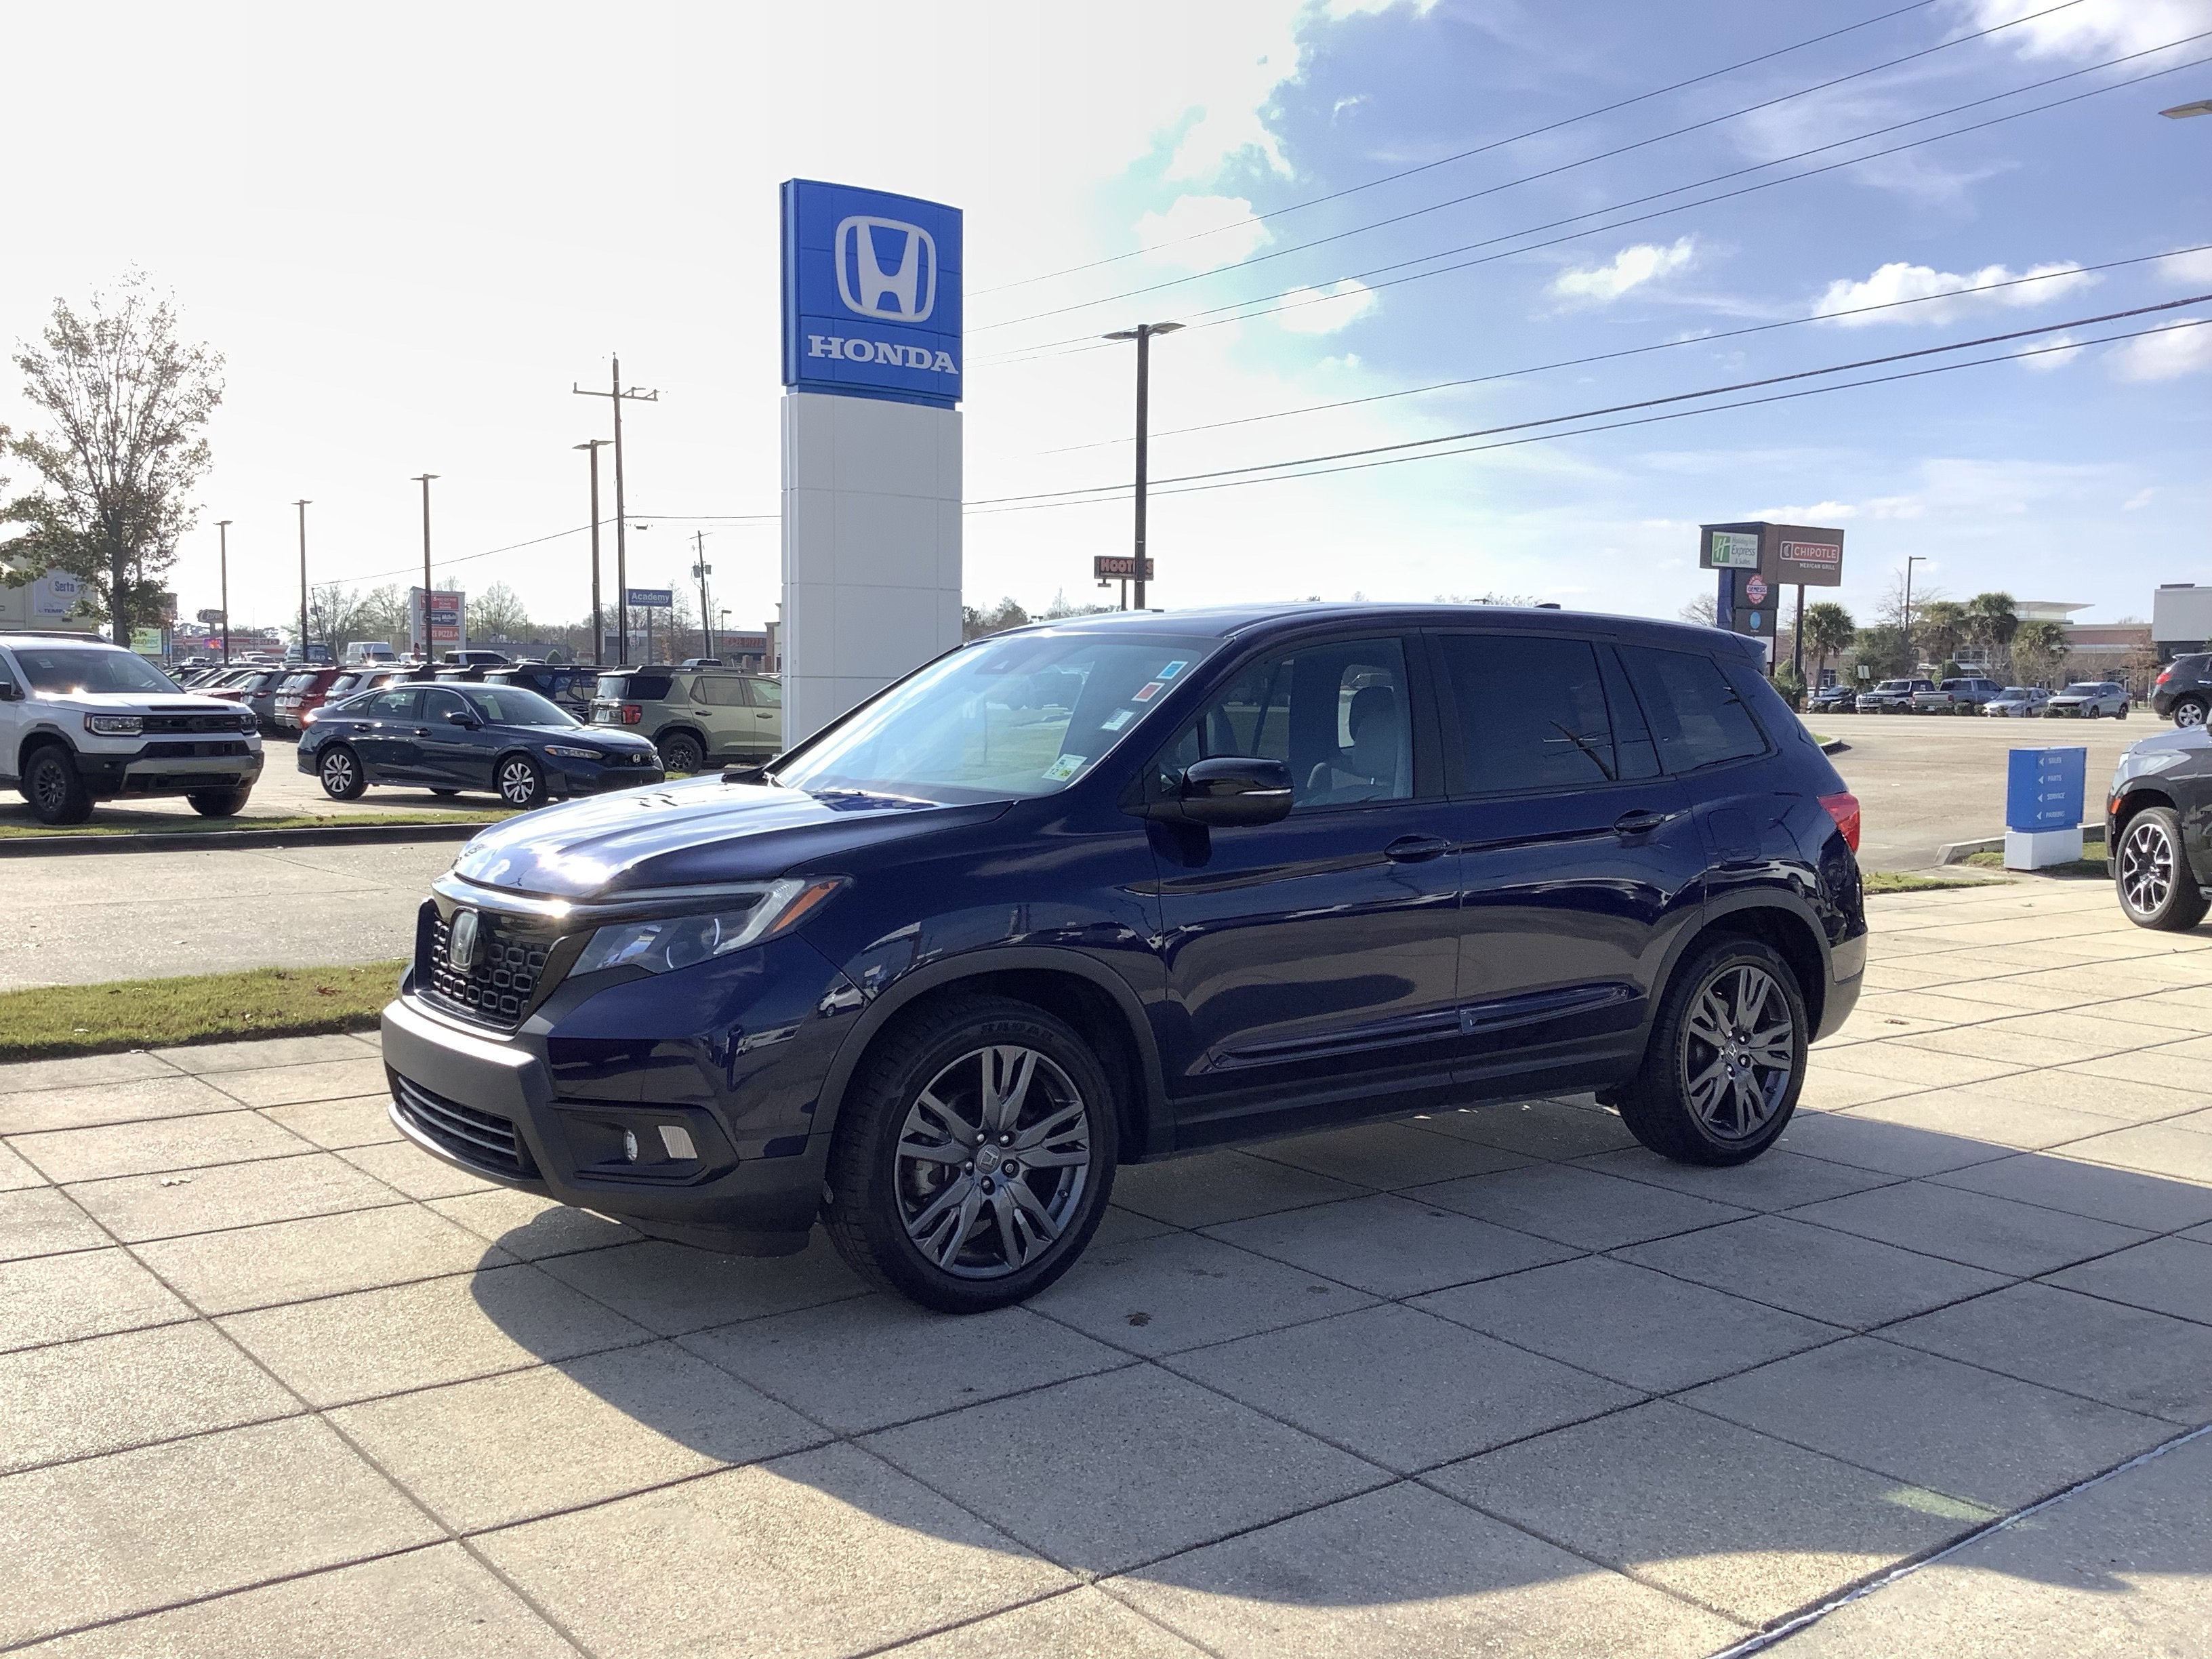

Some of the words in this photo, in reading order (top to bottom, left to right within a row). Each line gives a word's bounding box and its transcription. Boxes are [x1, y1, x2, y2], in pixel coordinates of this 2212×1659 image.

[808, 335, 959, 375] HONDA
[1732, 544, 1755, 556] Express
[1794, 546, 1837, 558] CHIPOTLE
[1100, 556, 1153, 574] HOOTS
[55, 581, 75, 592] Serta
[631, 592, 670, 603] Academy
[438, 630, 453, 638] PIZZA
